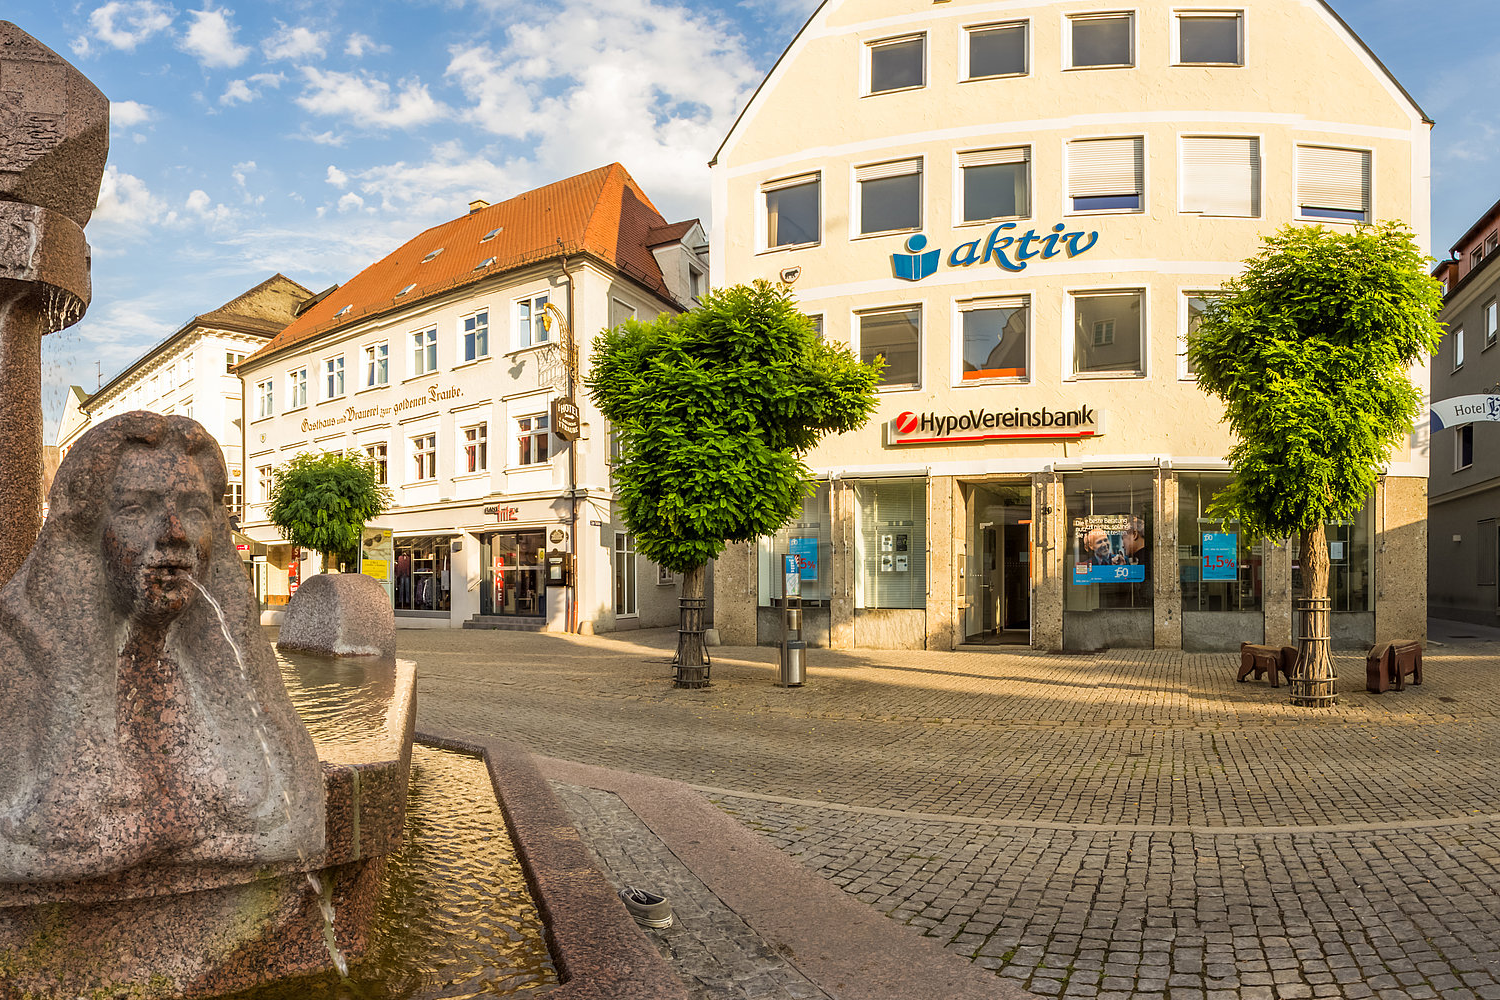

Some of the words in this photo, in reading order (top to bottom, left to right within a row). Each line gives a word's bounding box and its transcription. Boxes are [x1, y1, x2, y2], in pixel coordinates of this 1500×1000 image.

[949, 222, 1099, 272] aktiv
[301, 418, 336, 433] Gasthaus
[337, 414, 347, 425] und
[345, 405, 379, 422] Brauerei
[380, 407, 392, 418] zur
[393, 395, 427, 416] goldenen
[560, 403, 579, 418] HOTEL
[920, 404, 1095, 436] HypoVereinsbank
[1454, 403, 1486, 417] Hotel
[800, 558, 816, 570] 5%
[1203, 555, 1235, 571] 1,5%
[496, 562, 504, 601] SALE
